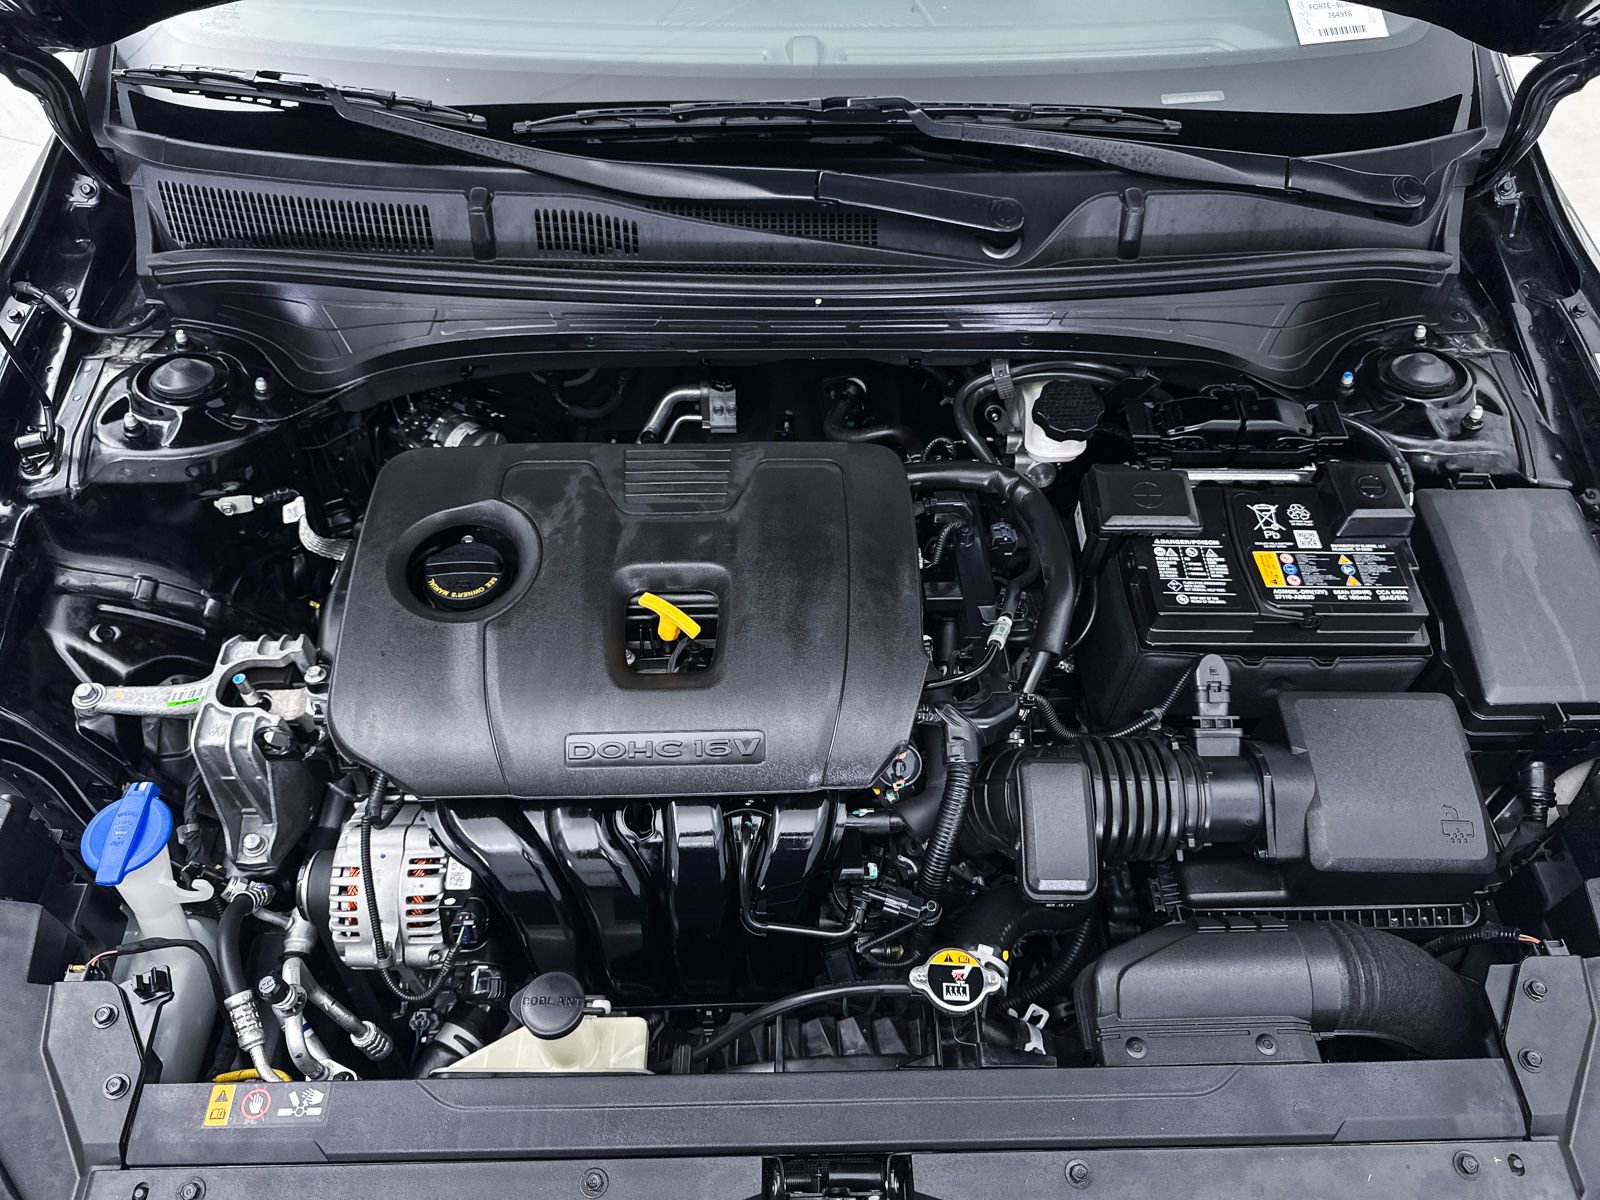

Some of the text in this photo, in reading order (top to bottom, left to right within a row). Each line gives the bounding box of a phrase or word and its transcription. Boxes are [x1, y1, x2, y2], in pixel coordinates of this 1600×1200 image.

[1308, 2, 1331, 10] FORTE
[1263, 530, 1281, 539] Pb
[428, 577, 498, 598] SEE OWNER'S MANUAL
[568, 738, 761, 760] DOHC 16V
[523, 996, 581, 1008] COOLANT
